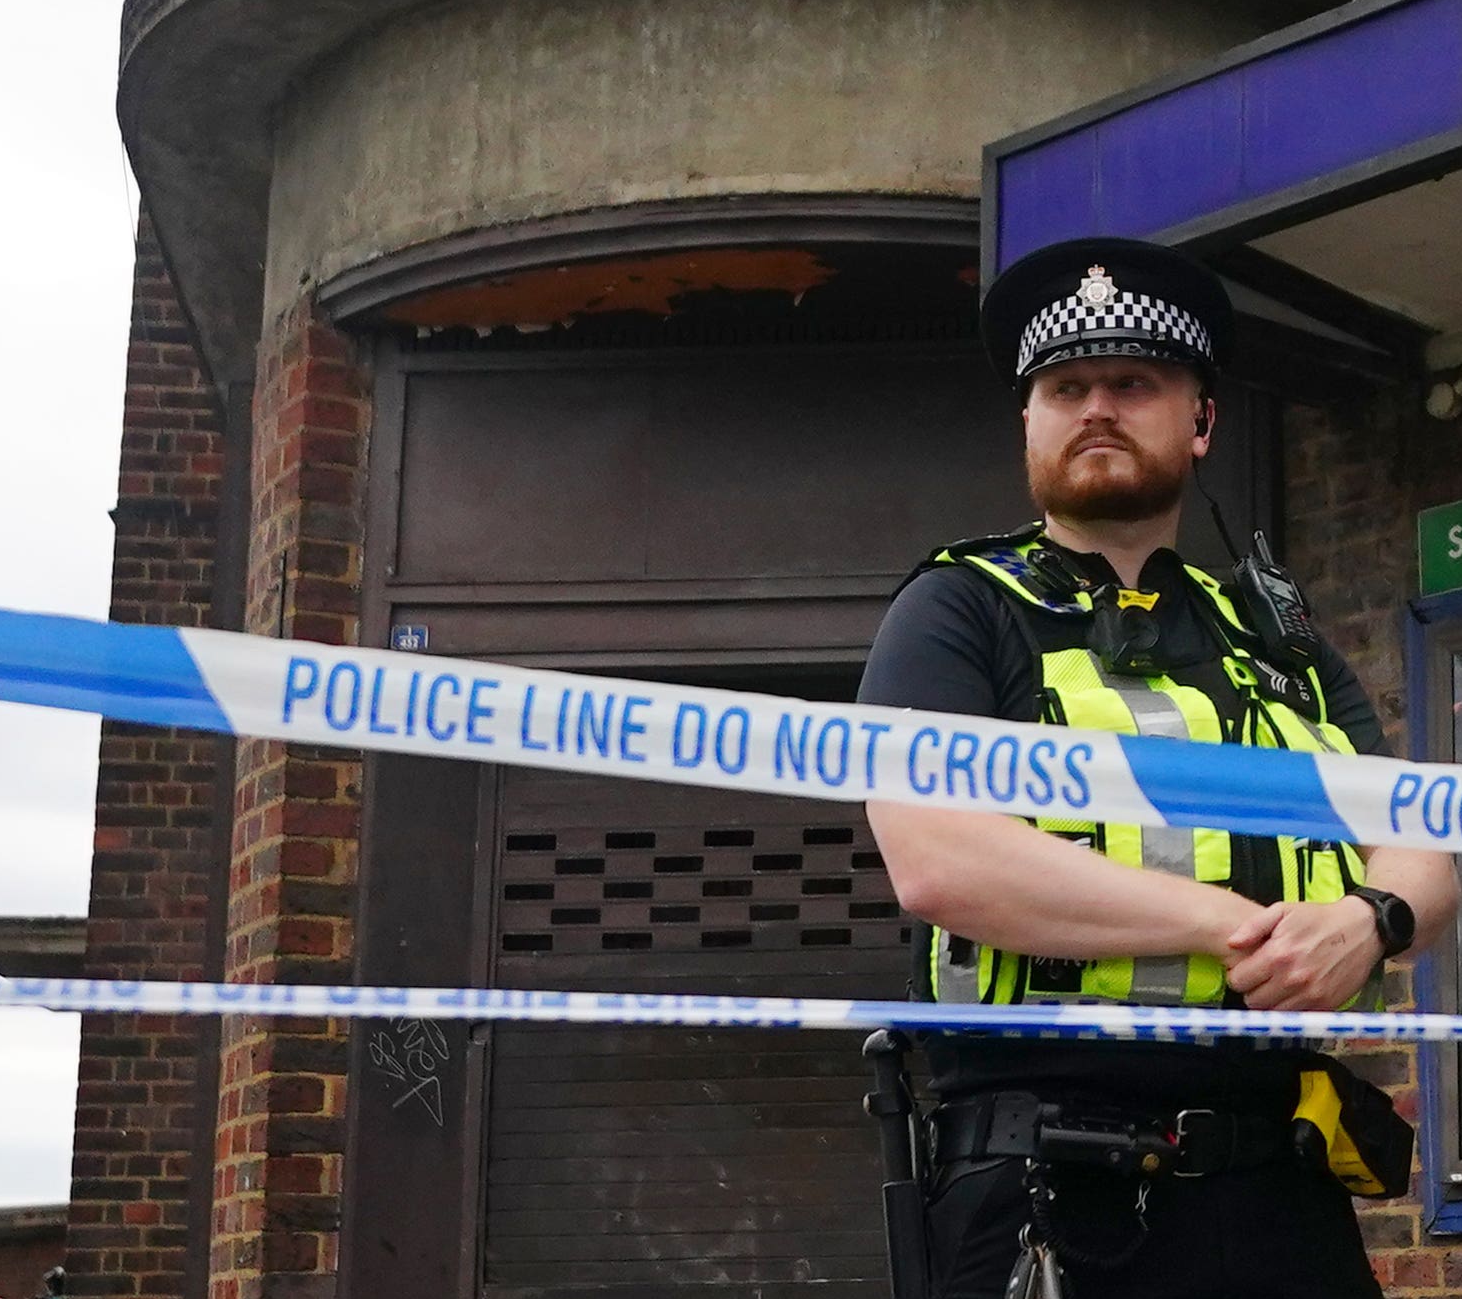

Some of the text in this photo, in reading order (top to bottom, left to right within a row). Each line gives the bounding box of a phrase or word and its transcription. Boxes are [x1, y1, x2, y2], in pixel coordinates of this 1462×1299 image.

[282, 656, 1094, 809] POLICE LINE DO NOT CROSS
